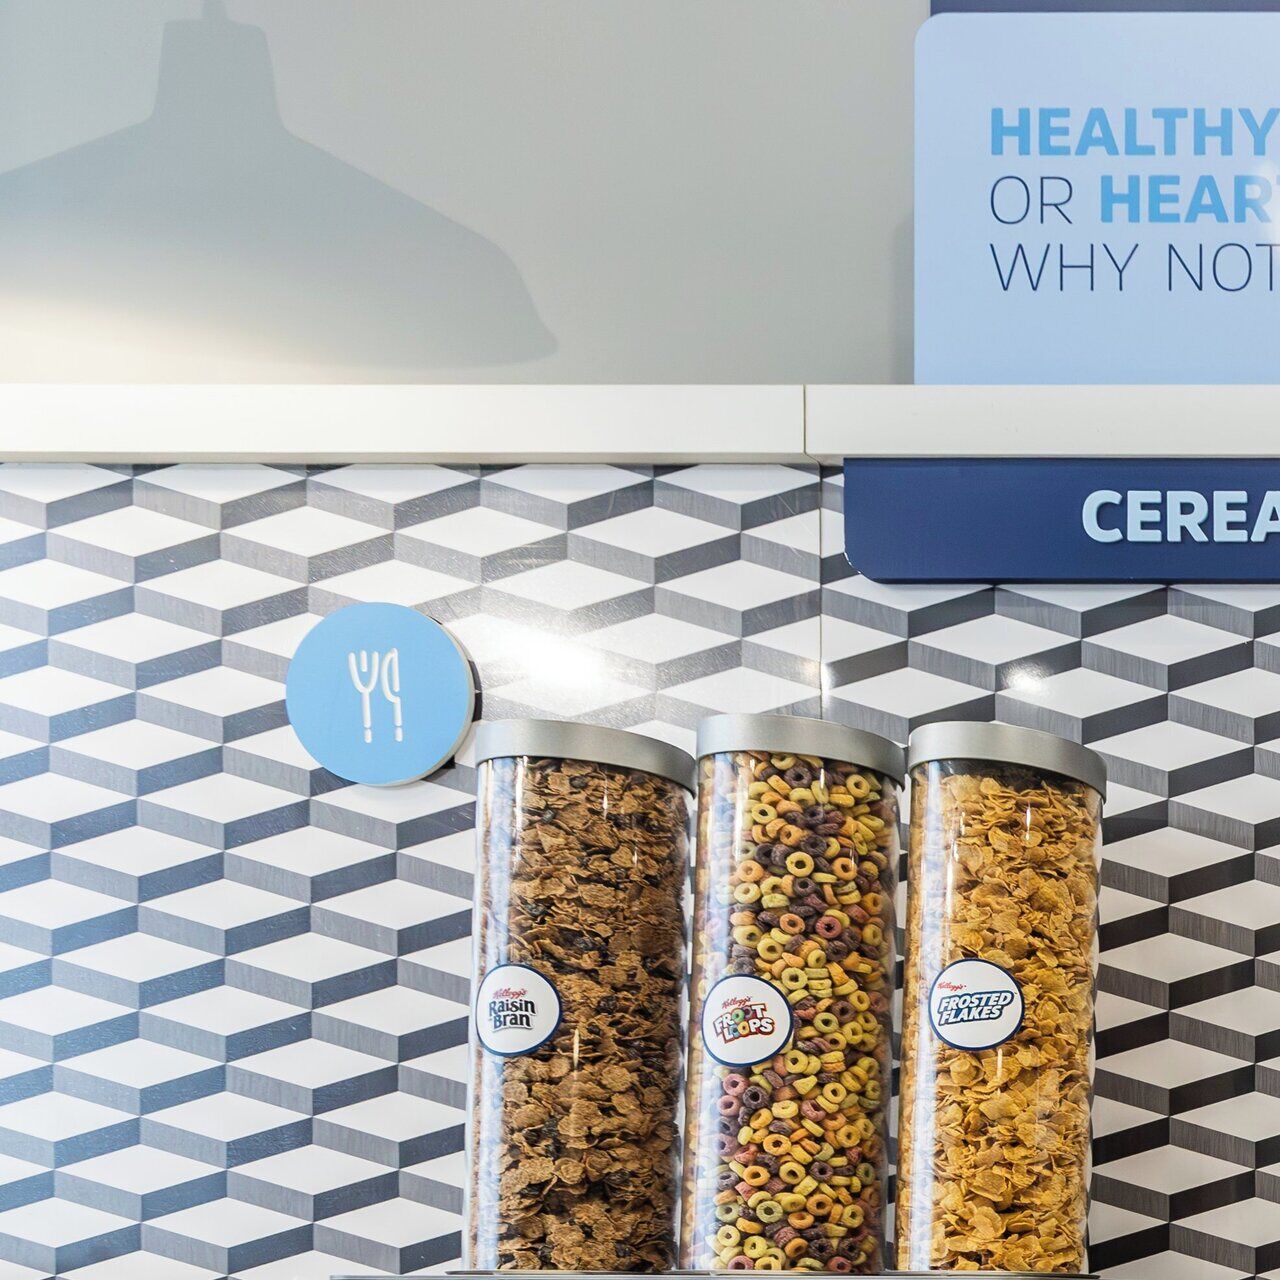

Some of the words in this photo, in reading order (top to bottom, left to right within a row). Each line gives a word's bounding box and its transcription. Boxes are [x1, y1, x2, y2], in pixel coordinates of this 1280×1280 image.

[990, 107, 1280, 157] HEALTHY
[989, 175, 1073, 225] OR
[990, 243, 1140, 292] WHY
[489, 999, 537, 1017] Raisin
[938, 991, 1013, 1013] FROSTED
[493, 1013, 532, 1030] Bran
[714, 1003, 767, 1037] FROOT
[939, 1005, 1002, 1026] FLAKES
[723, 1018, 775, 1044] LOOPS
